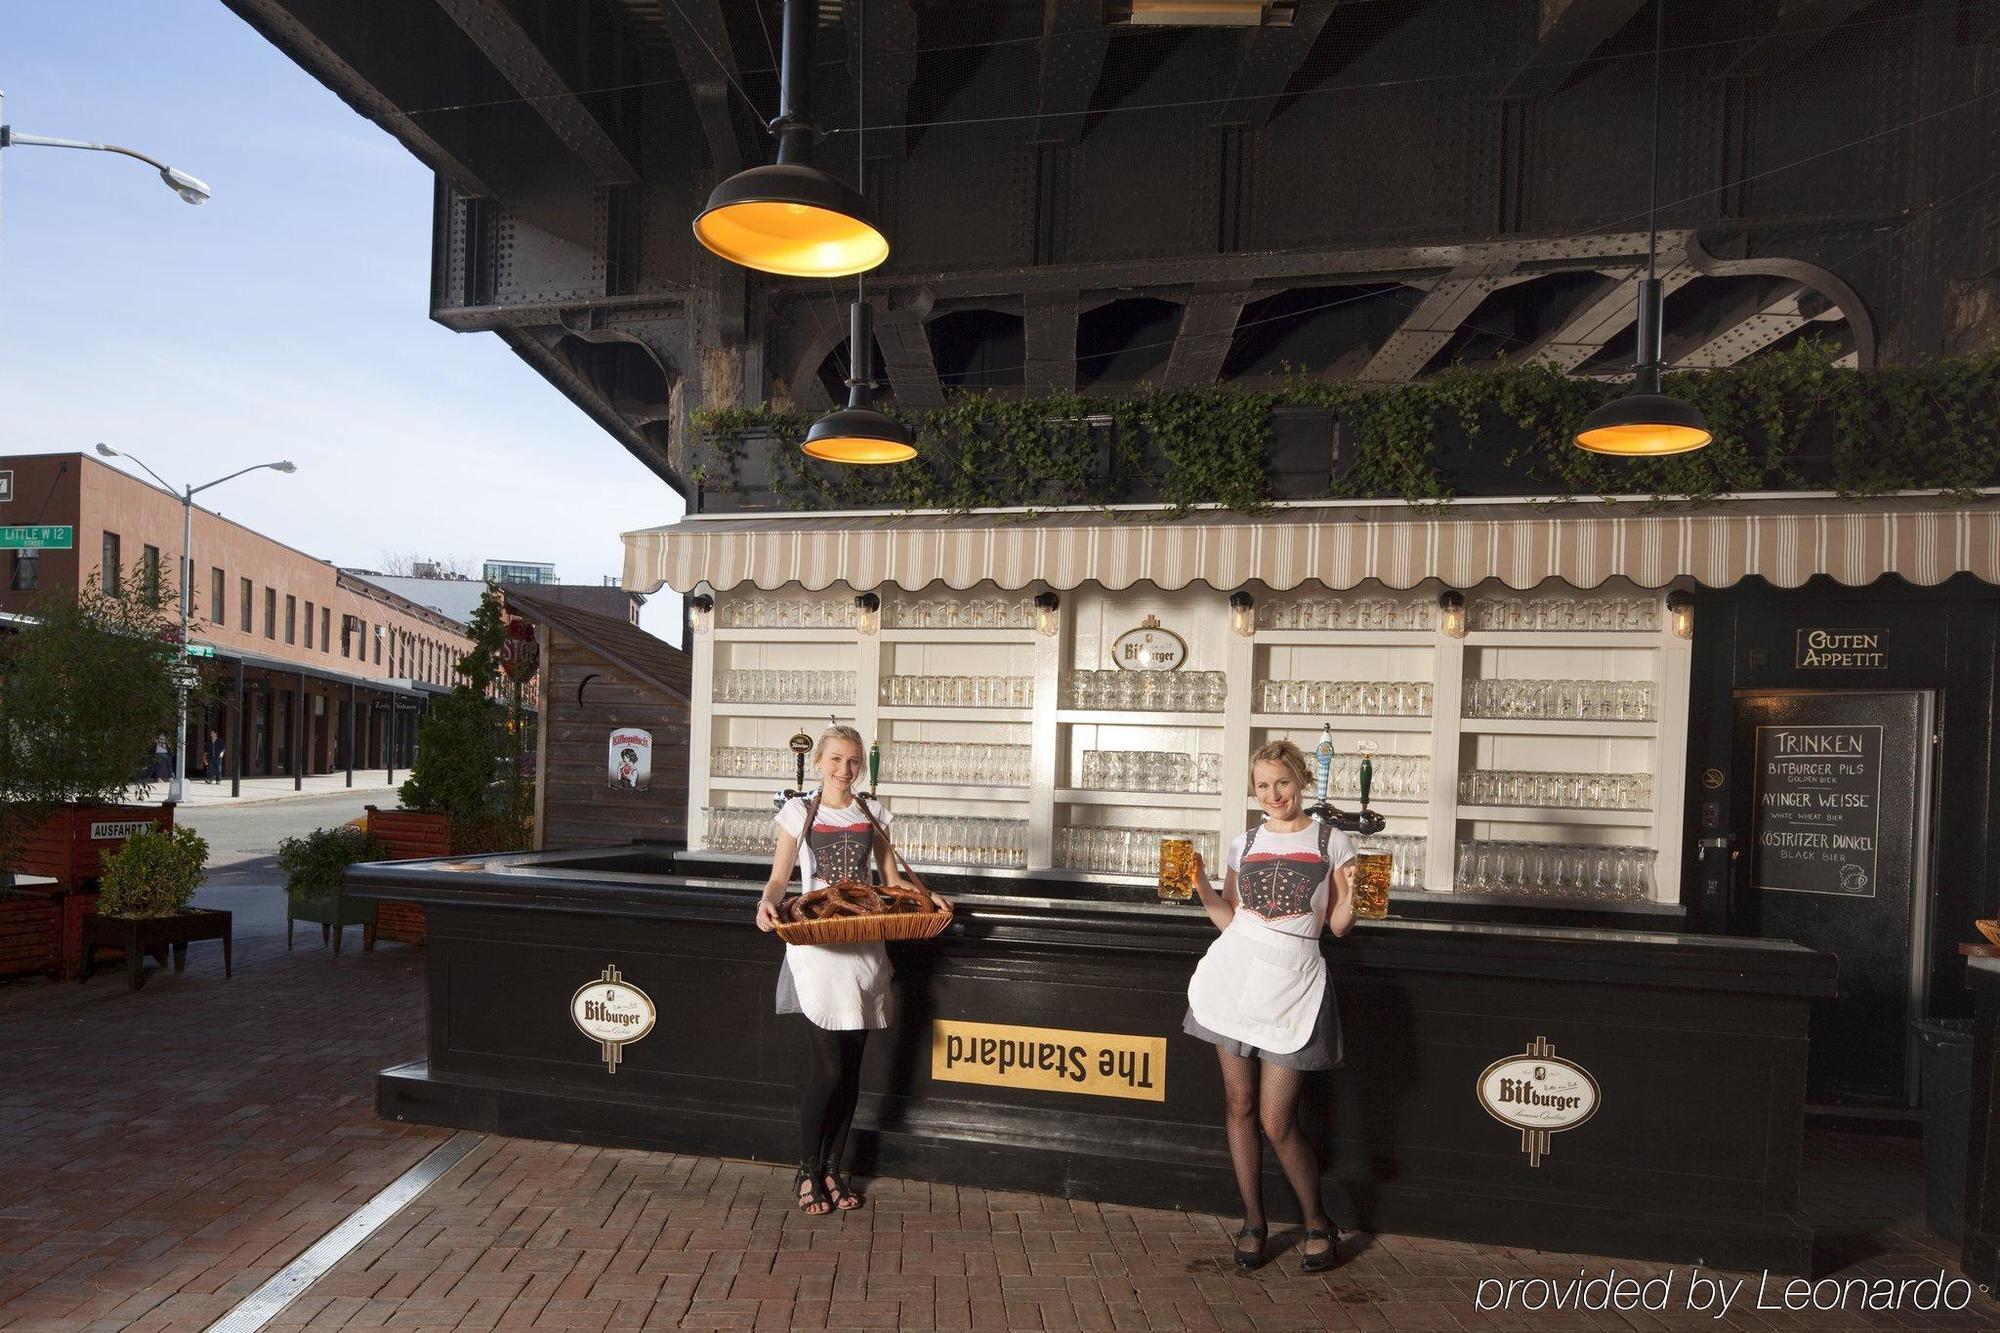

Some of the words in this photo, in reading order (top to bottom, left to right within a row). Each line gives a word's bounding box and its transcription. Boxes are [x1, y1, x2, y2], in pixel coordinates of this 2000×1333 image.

[5, 528, 38, 540] LITTLE
[42, 528, 50, 539] W
[54, 528, 64, 540] 12
[1808, 630, 1879, 649] GUTEN
[1802, 648, 1884, 667] APPETIT
[1774, 732, 1863, 753] TRINKEN
[1768, 763, 1832, 775] BITBURGER
[1839, 764, 1864, 775] PILS
[1787, 775, 1818, 783] GOLDEN
[1761, 793, 1812, 807] AYINGER
[1818, 793, 1870, 808] WEISSE
[94, 823, 143, 837] AUSFAHRT
[1832, 833, 1874, 851] DUNKEL
[1781, 849, 1816, 861] BLACK
[1822, 851, 1846, 862] BIER
[584, 1000, 640, 1027] Bitburger
[946, 1034, 1088, 1083] Standard
[1098, 1048, 1153, 1089] The
[1498, 1077, 1581, 1112] Bitburger
